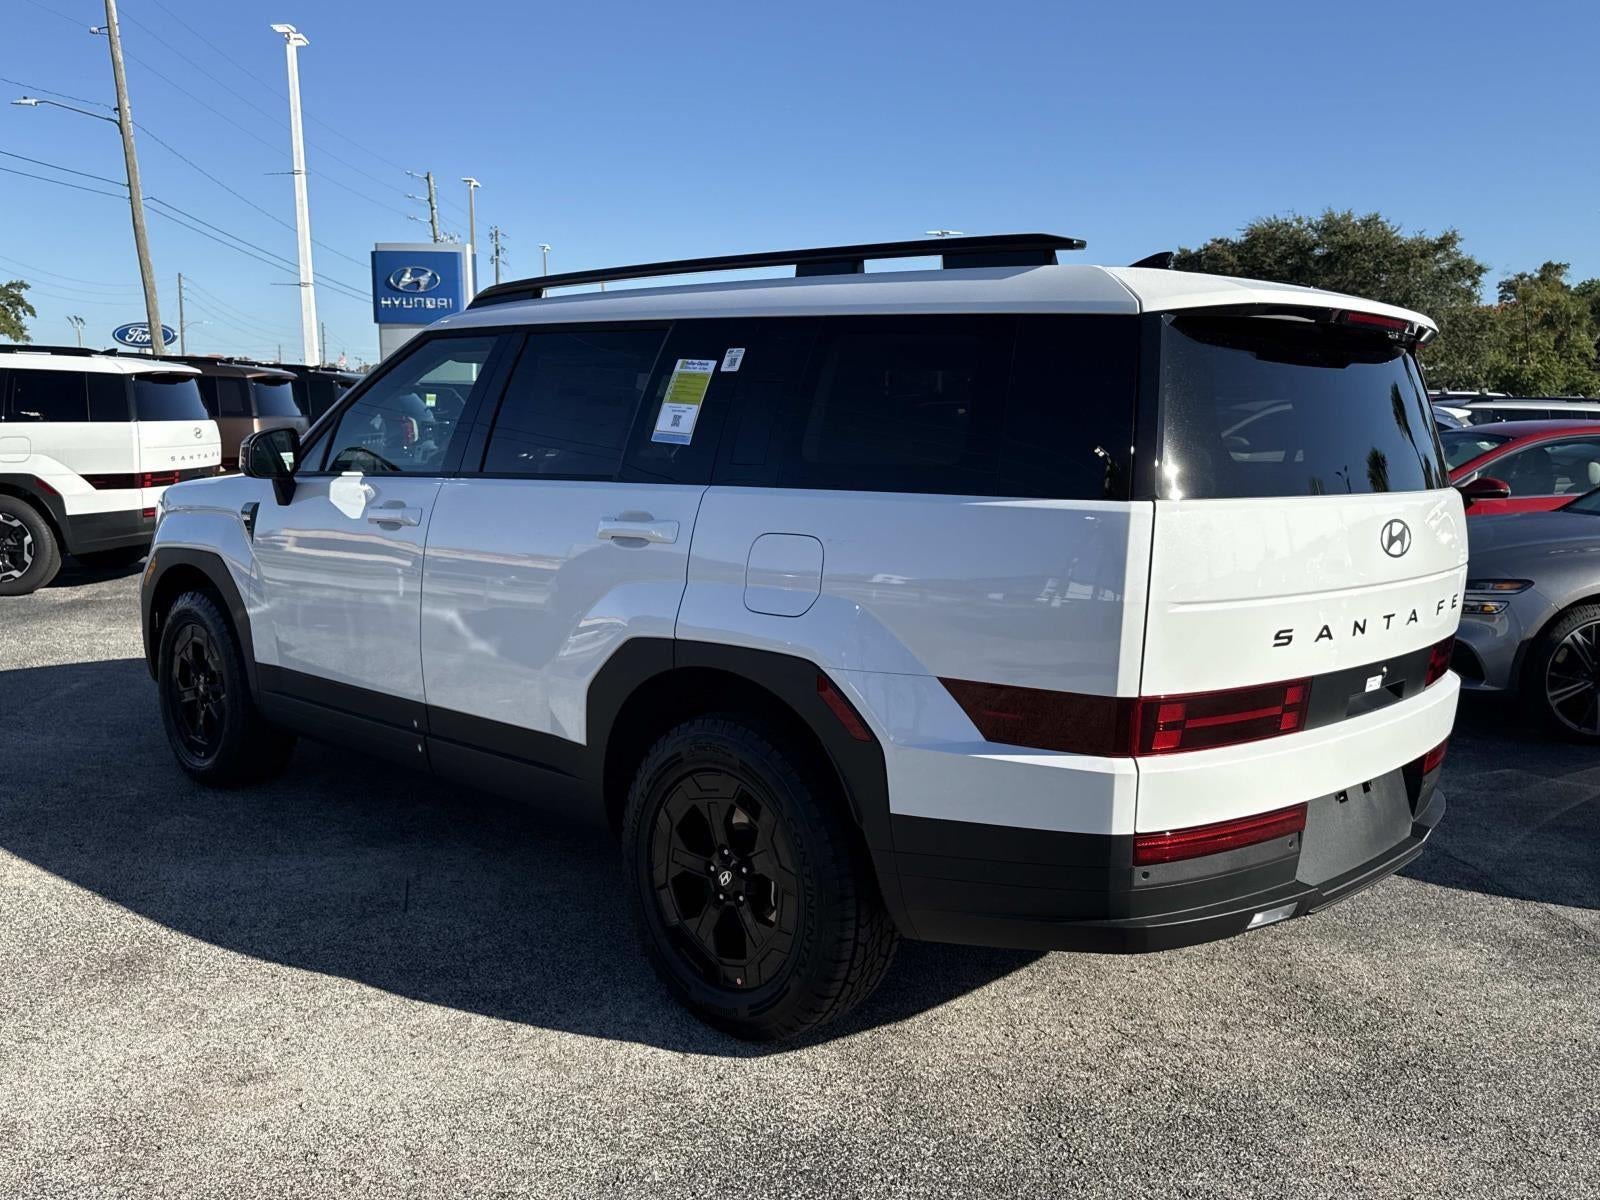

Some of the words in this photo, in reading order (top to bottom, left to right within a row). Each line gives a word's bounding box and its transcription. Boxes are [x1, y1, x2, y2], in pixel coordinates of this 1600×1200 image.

[381, 297, 453, 309] HYUNDAI
[125, 327, 151, 342] For
[170, 453, 208, 461] SANTA
[1272, 608, 1418, 647] SANTA
[1436, 594, 1458, 616] FE
